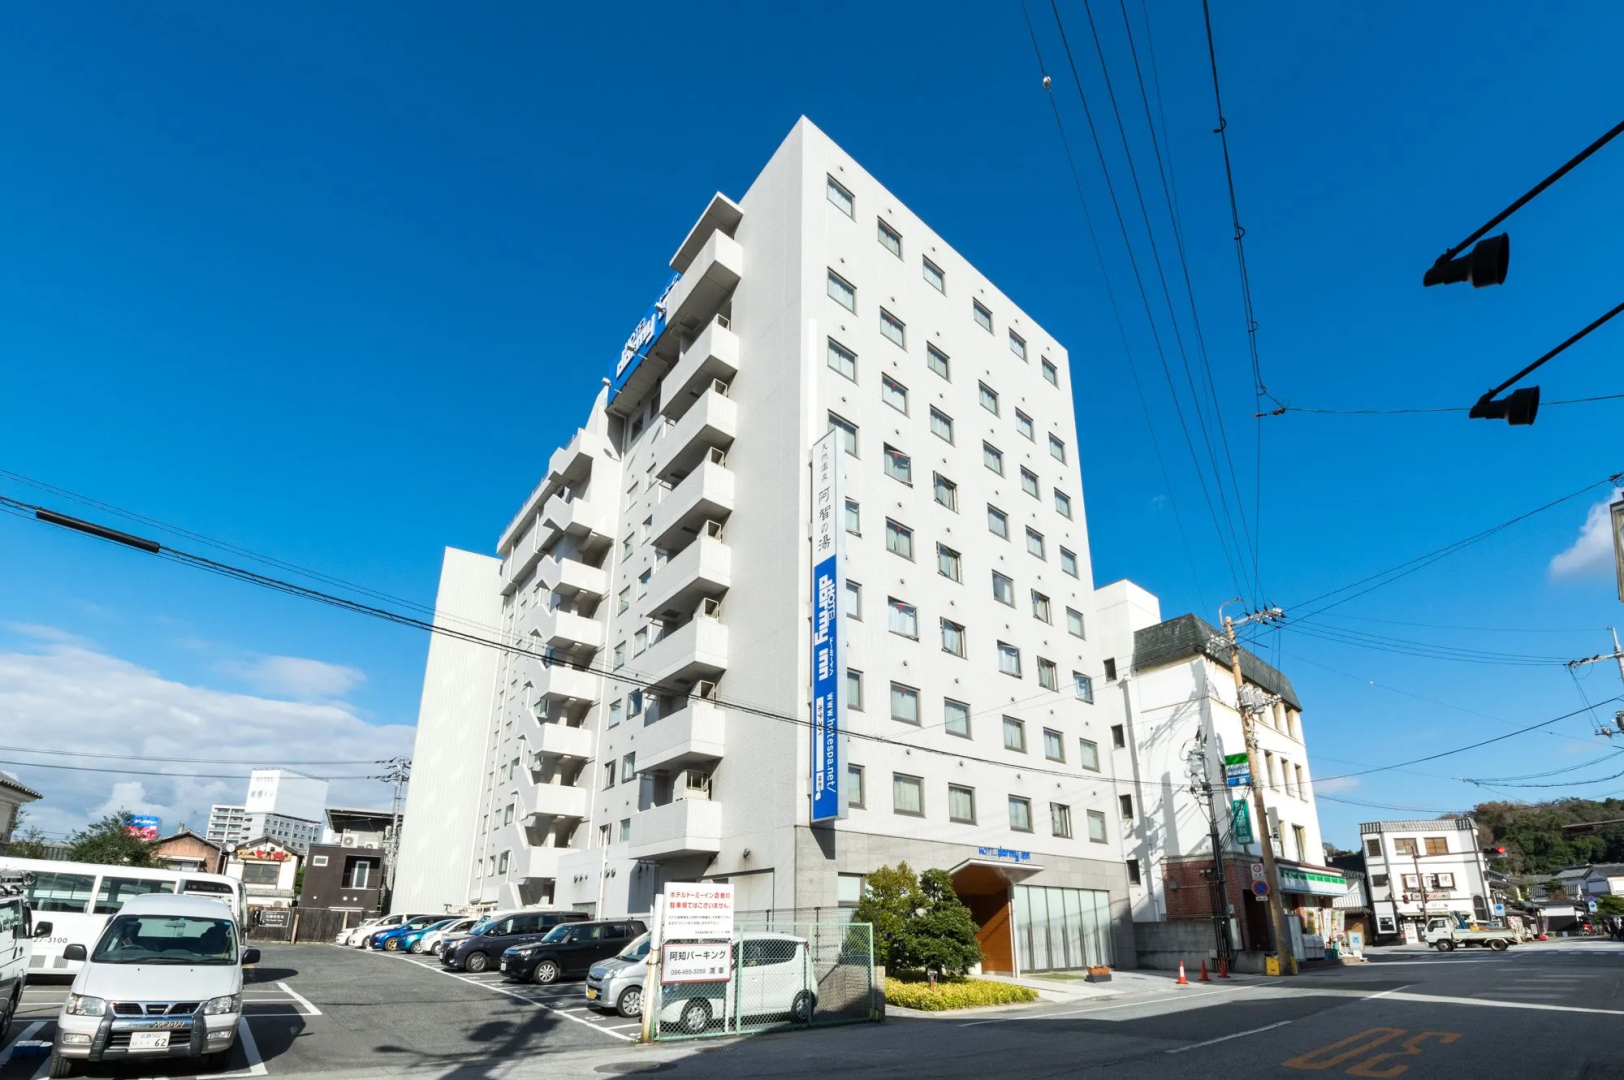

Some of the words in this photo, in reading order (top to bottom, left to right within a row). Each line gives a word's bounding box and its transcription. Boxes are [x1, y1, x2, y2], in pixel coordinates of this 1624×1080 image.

[818, 486, 831, 551] 阿智の湯
[815, 574, 833, 646] dormy
[827, 583, 835, 626] HOTEL
[819, 648, 828, 681] inn
[826, 692, 836, 793] www.hotespa.net/
[669, 951, 727, 961] 阿知パーキング
[154, 1038, 168, 1047] 62
